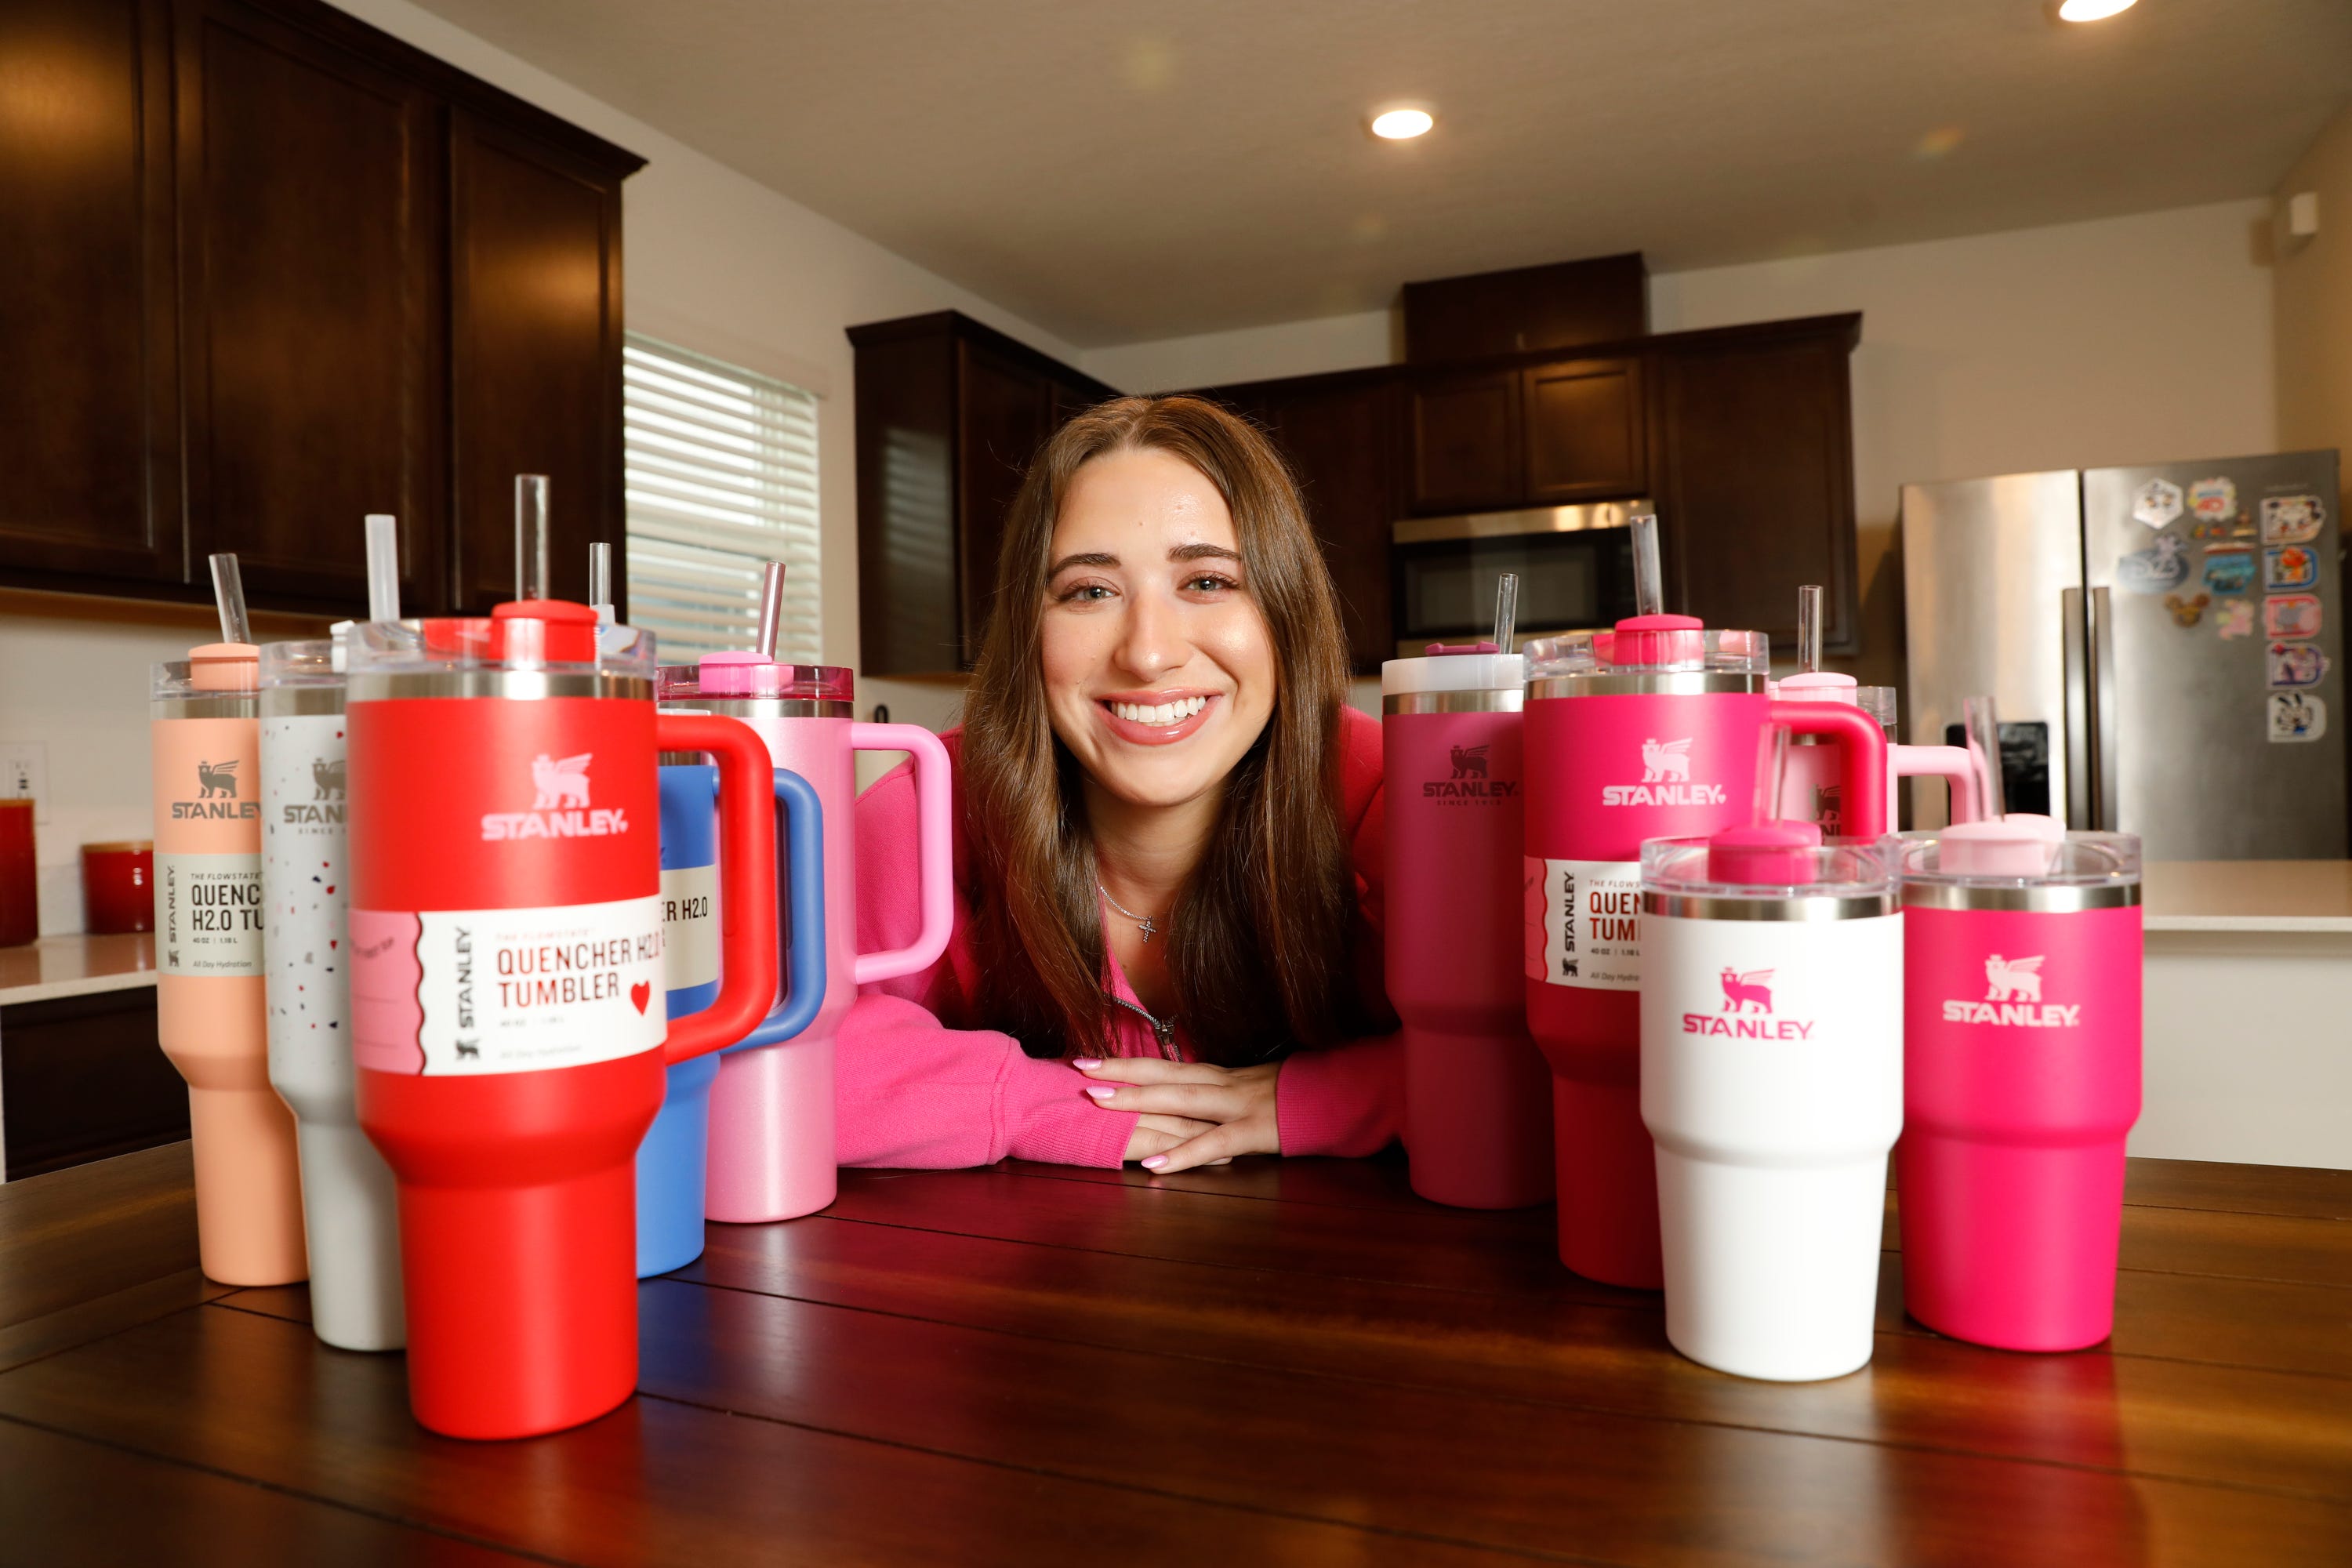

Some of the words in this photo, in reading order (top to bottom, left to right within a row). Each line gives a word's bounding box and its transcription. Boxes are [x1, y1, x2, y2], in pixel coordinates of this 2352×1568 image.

[1423, 782, 1516, 797] STANLEY
[1602, 784, 1722, 806] STANLEY
[481, 808, 624, 841] STANLEY
[167, 866, 176, 943] STANLEY
[191, 884, 260, 906] QUENC
[682, 896, 708, 920] H2.0
[193, 909, 231, 931] H2.0
[1563, 871, 1575, 953] STANLEY
[498, 938, 631, 975] QUENCHER
[456, 926, 474, 1029] STANLEY
[498, 972, 619, 1008] TUMBLER
[1602, 972, 1615, 981] Day
[1682, 1013, 1813, 1040] STANLEY
[1943, 1000, 2081, 1027] STANLEY
